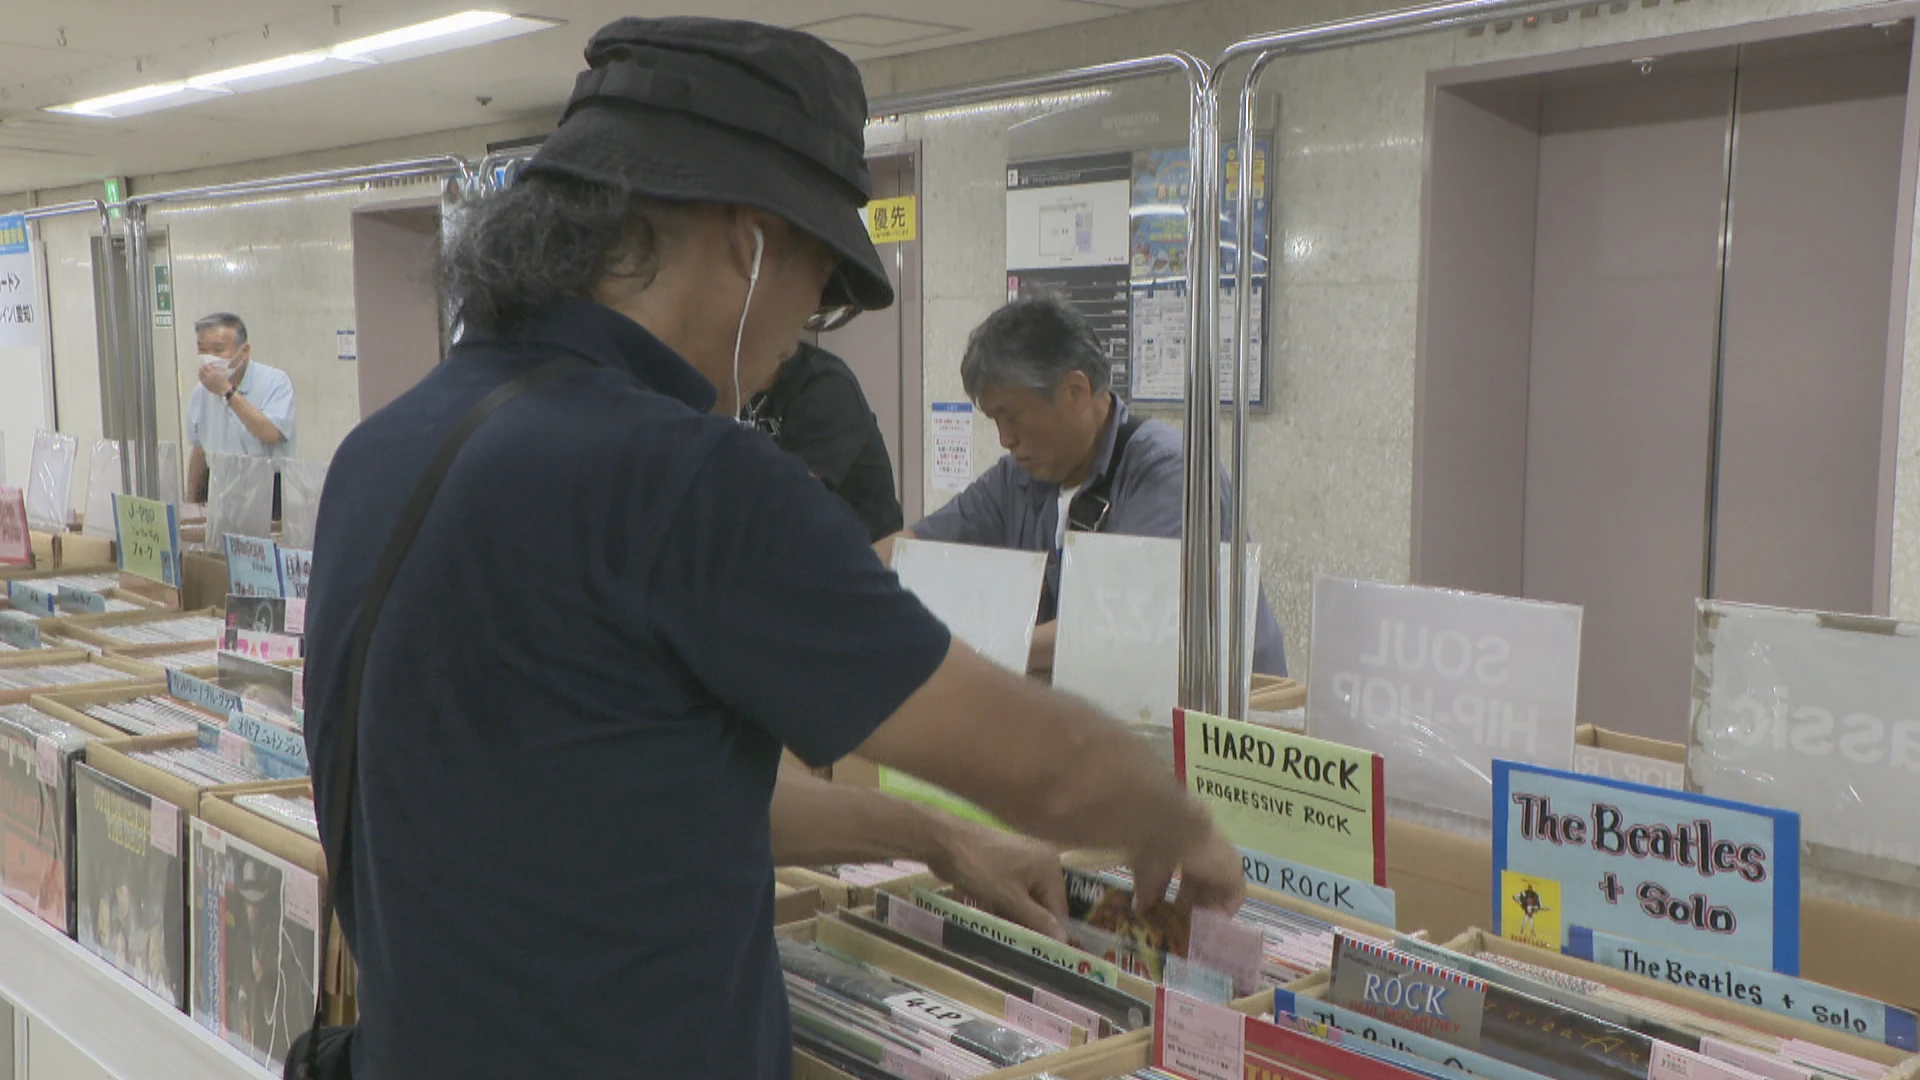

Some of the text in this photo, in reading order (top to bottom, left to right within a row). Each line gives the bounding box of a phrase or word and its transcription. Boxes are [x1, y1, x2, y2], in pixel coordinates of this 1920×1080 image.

[873, 205, 906, 231] 優先
[128, 502, 155, 524] J-POP
[1202, 723, 1361, 794] HARD ROCK
[1197, 776, 1352, 836] PROGRESSIVE ROCK
[1512, 792, 1768, 883] The Beatles
[1281, 867, 1355, 910] ROCK
[1598, 871, 1738, 935] + Solo
[905, 997, 962, 1021] 4LP
[1363, 972, 1449, 1019] ROCK
[1617, 947, 1868, 1035] The Beatles + Solo
